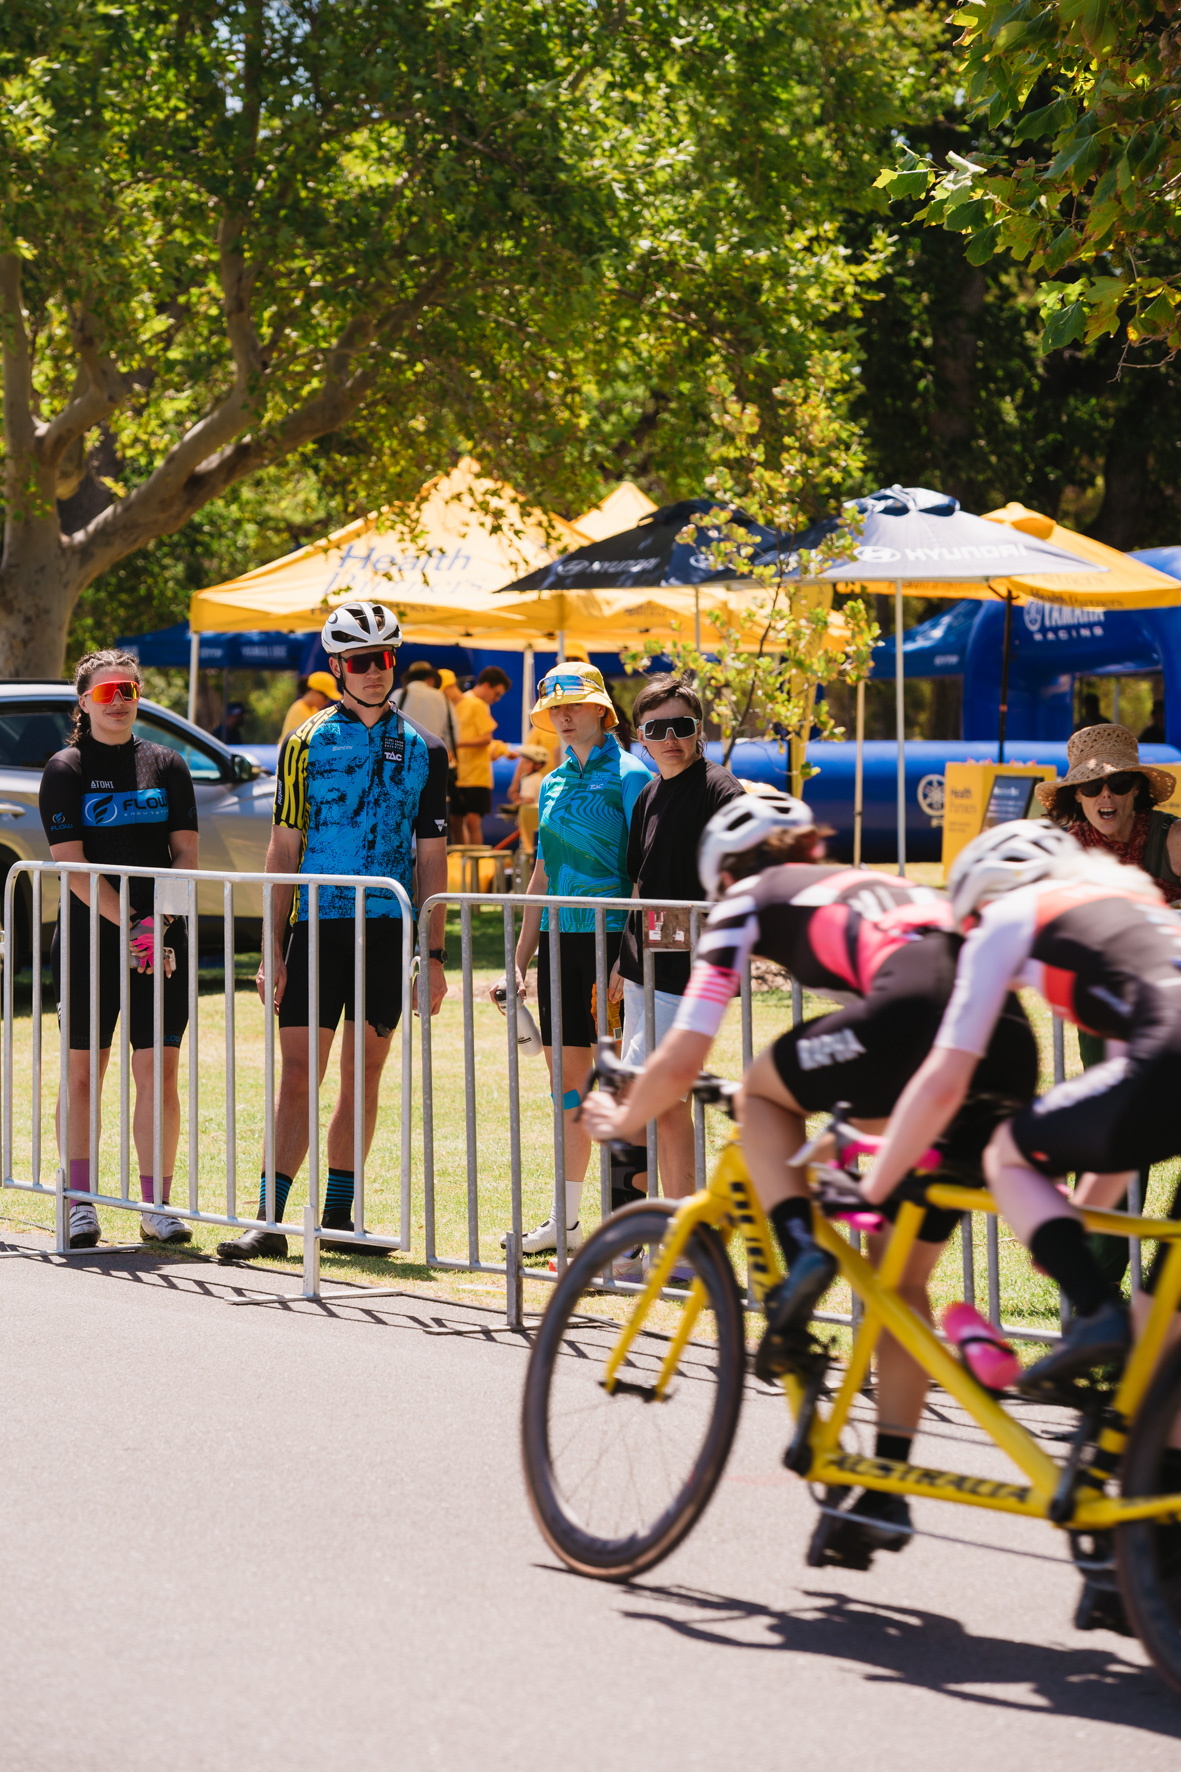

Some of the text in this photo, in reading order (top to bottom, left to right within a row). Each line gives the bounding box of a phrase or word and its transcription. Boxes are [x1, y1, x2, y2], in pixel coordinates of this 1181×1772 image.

[338, 545, 471, 572] Health
[905, 544, 1028, 561] HYUNDAI
[1033, 626, 1105, 641] RACING
[384, 751, 403, 762] TAC
[123, 797, 168, 811] FLOW
[51, 824, 74, 832] FLOW
[825, 1455, 1031, 1503] AUSTRALIA
